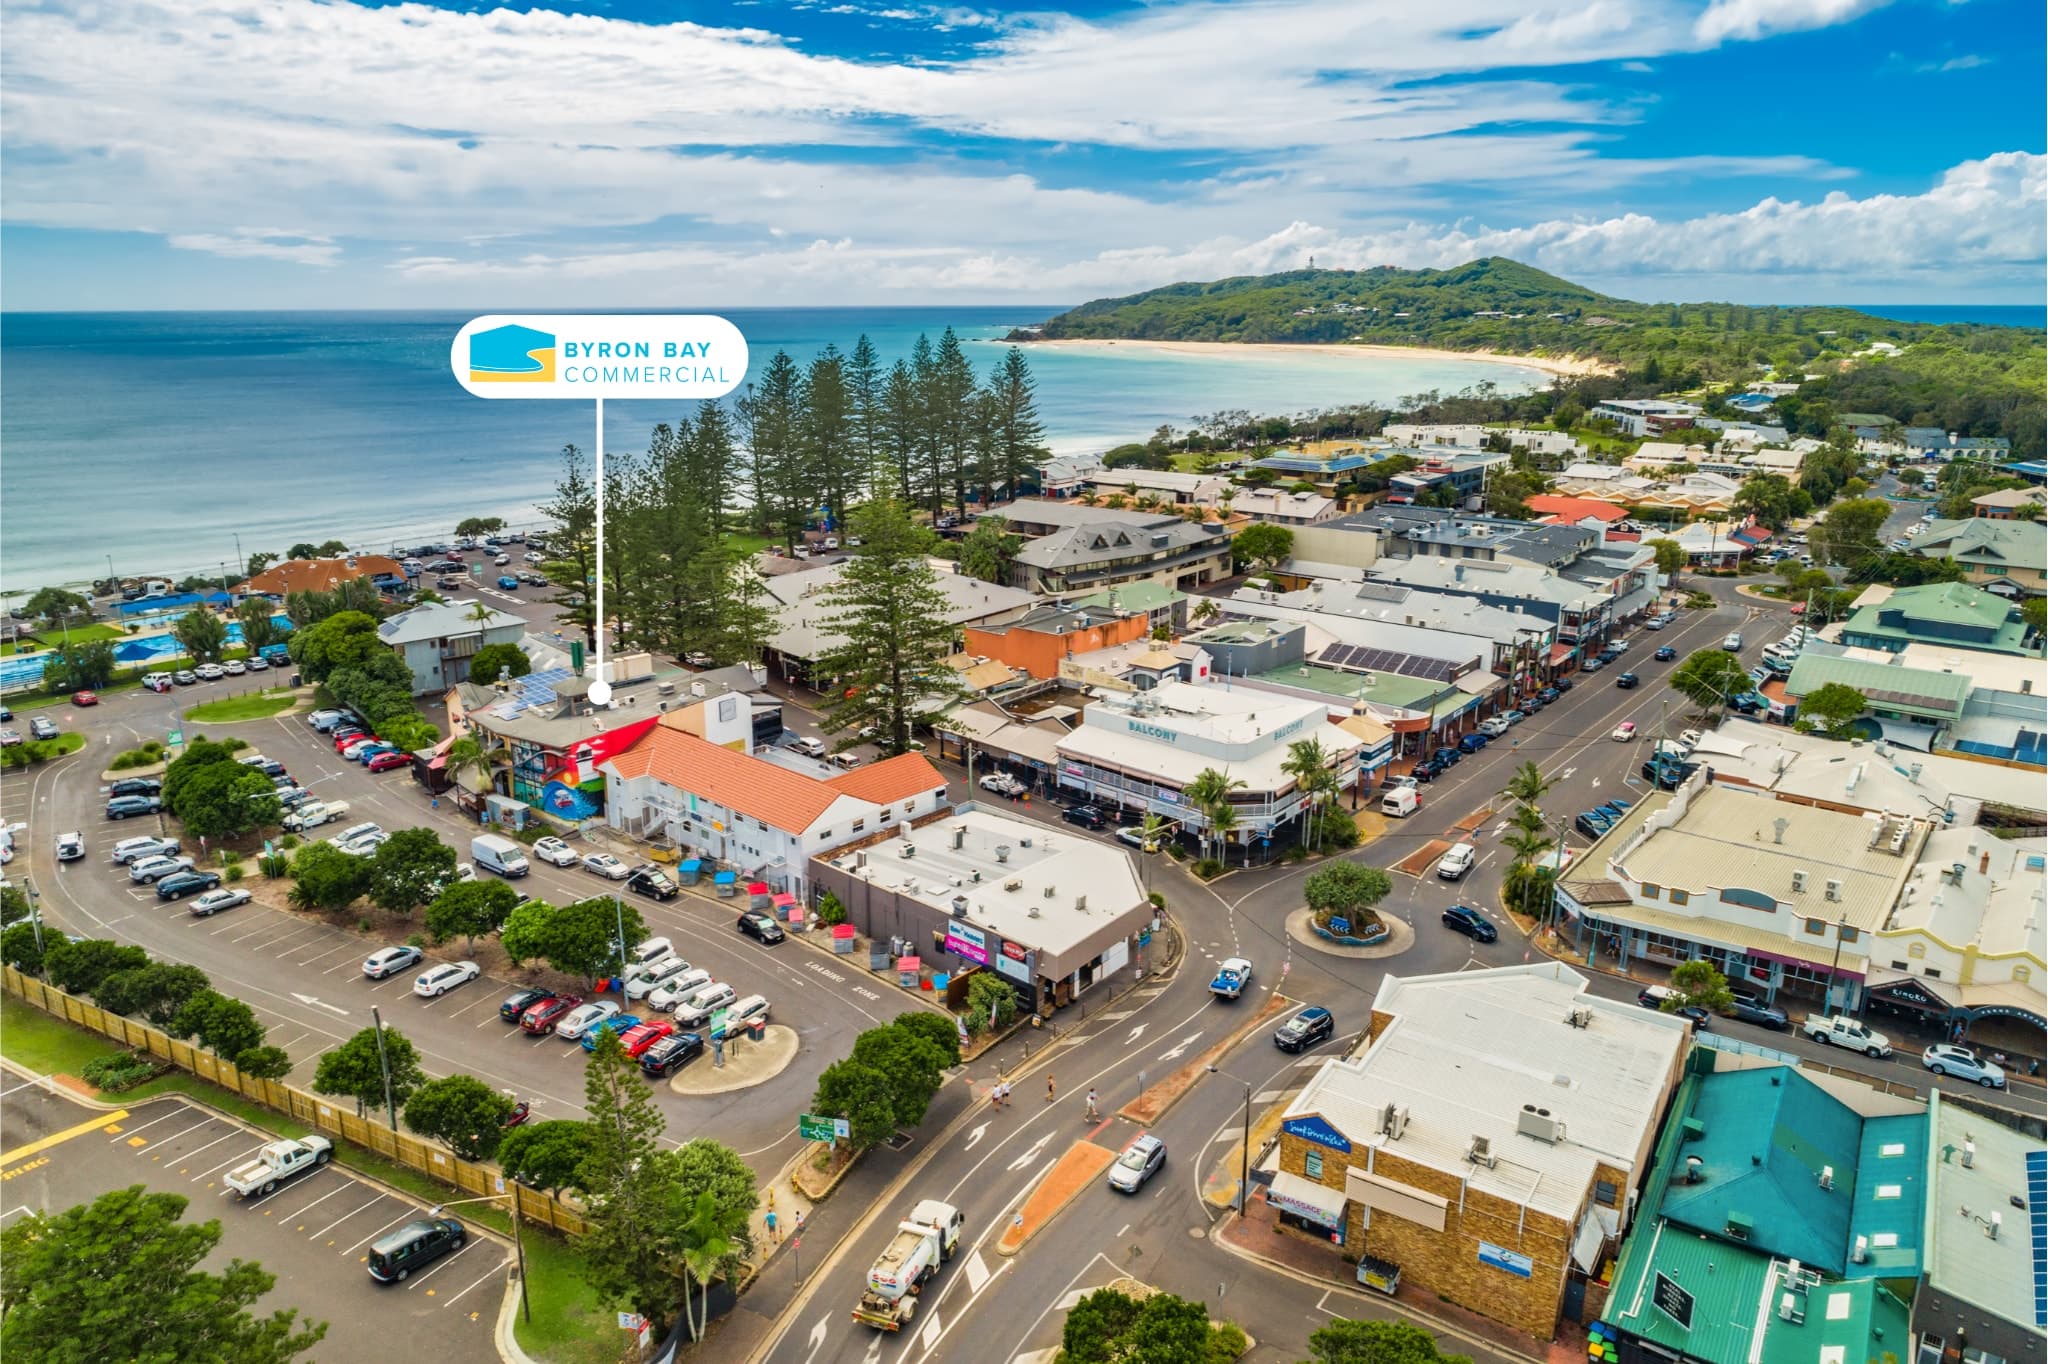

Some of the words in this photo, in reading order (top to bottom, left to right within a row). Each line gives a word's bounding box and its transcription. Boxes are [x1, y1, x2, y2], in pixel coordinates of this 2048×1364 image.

[1128, 720, 1177, 742] BALCONY
[1274, 719, 1303, 741] BALCONY
[804, 961, 846, 983] LOADING
[851, 986, 881, 1001] ZONE
[1282, 1196, 1322, 1215] MASSAGE
